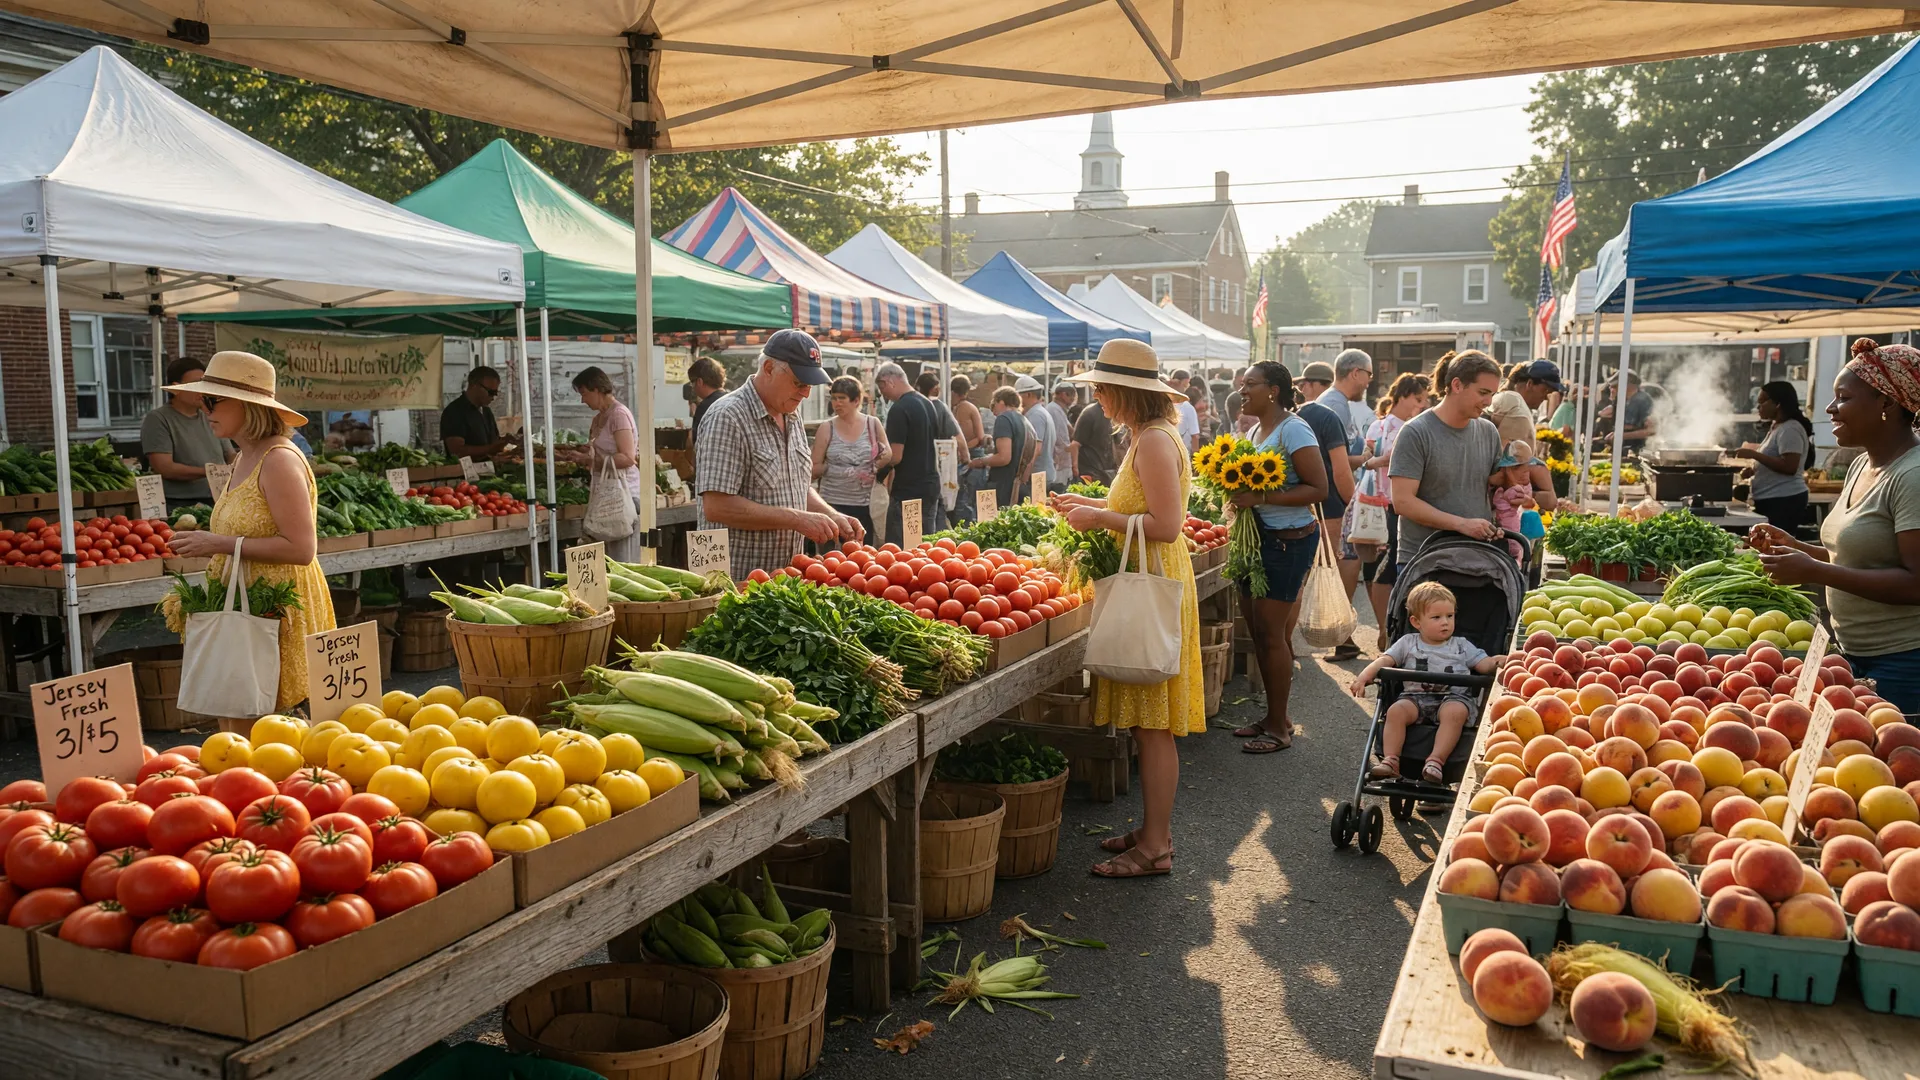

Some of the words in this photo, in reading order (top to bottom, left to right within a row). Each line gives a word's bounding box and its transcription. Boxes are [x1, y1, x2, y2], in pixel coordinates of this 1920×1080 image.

[316, 633, 360, 653] Jersey
[328, 650, 359, 666] Fresh
[41, 678, 107, 705] Jersey
[323, 666, 368, 700] 3/$5
[60, 698, 109, 720] Fresh
[55, 716, 119, 759] 3/$5
